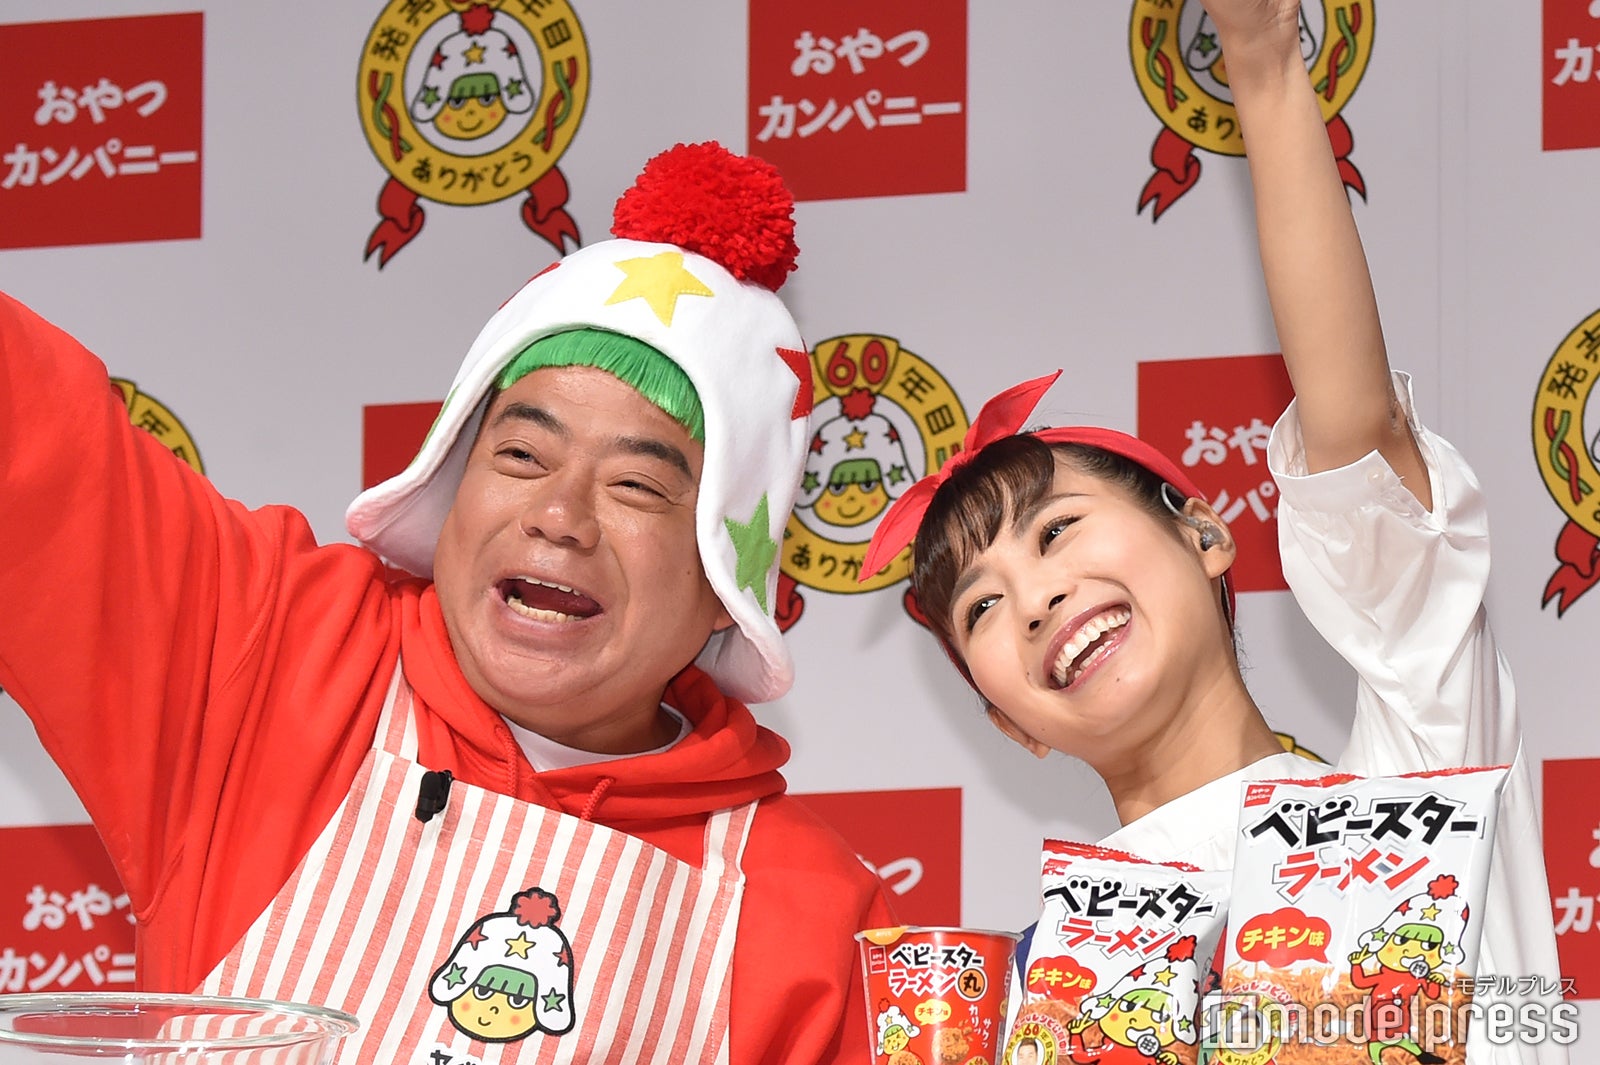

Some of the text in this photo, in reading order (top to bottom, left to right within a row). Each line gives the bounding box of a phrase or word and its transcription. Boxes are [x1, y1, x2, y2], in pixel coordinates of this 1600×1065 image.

[792, 30, 930, 77] おやつ
[34, 79, 167, 125] おやつ
[757, 93, 963, 142] カンパニー
[1187, 107, 1247, 141] あり
[1, 139, 198, 189] カンパニー
[411, 152, 532, 193] ありがとう
[1250, 795, 1477, 846] ベビースター
[1278, 848, 1430, 899] ラーメン
[1044, 880, 1213, 923] ベビースター
[891, 945, 983, 969] ベビースター
[1061, 917, 1176, 956] ラーメン
[1241, 925, 1325, 953] チキン味
[890, 970, 956, 996] ラーメン
[1028, 967, 1093, 990] チキン味
